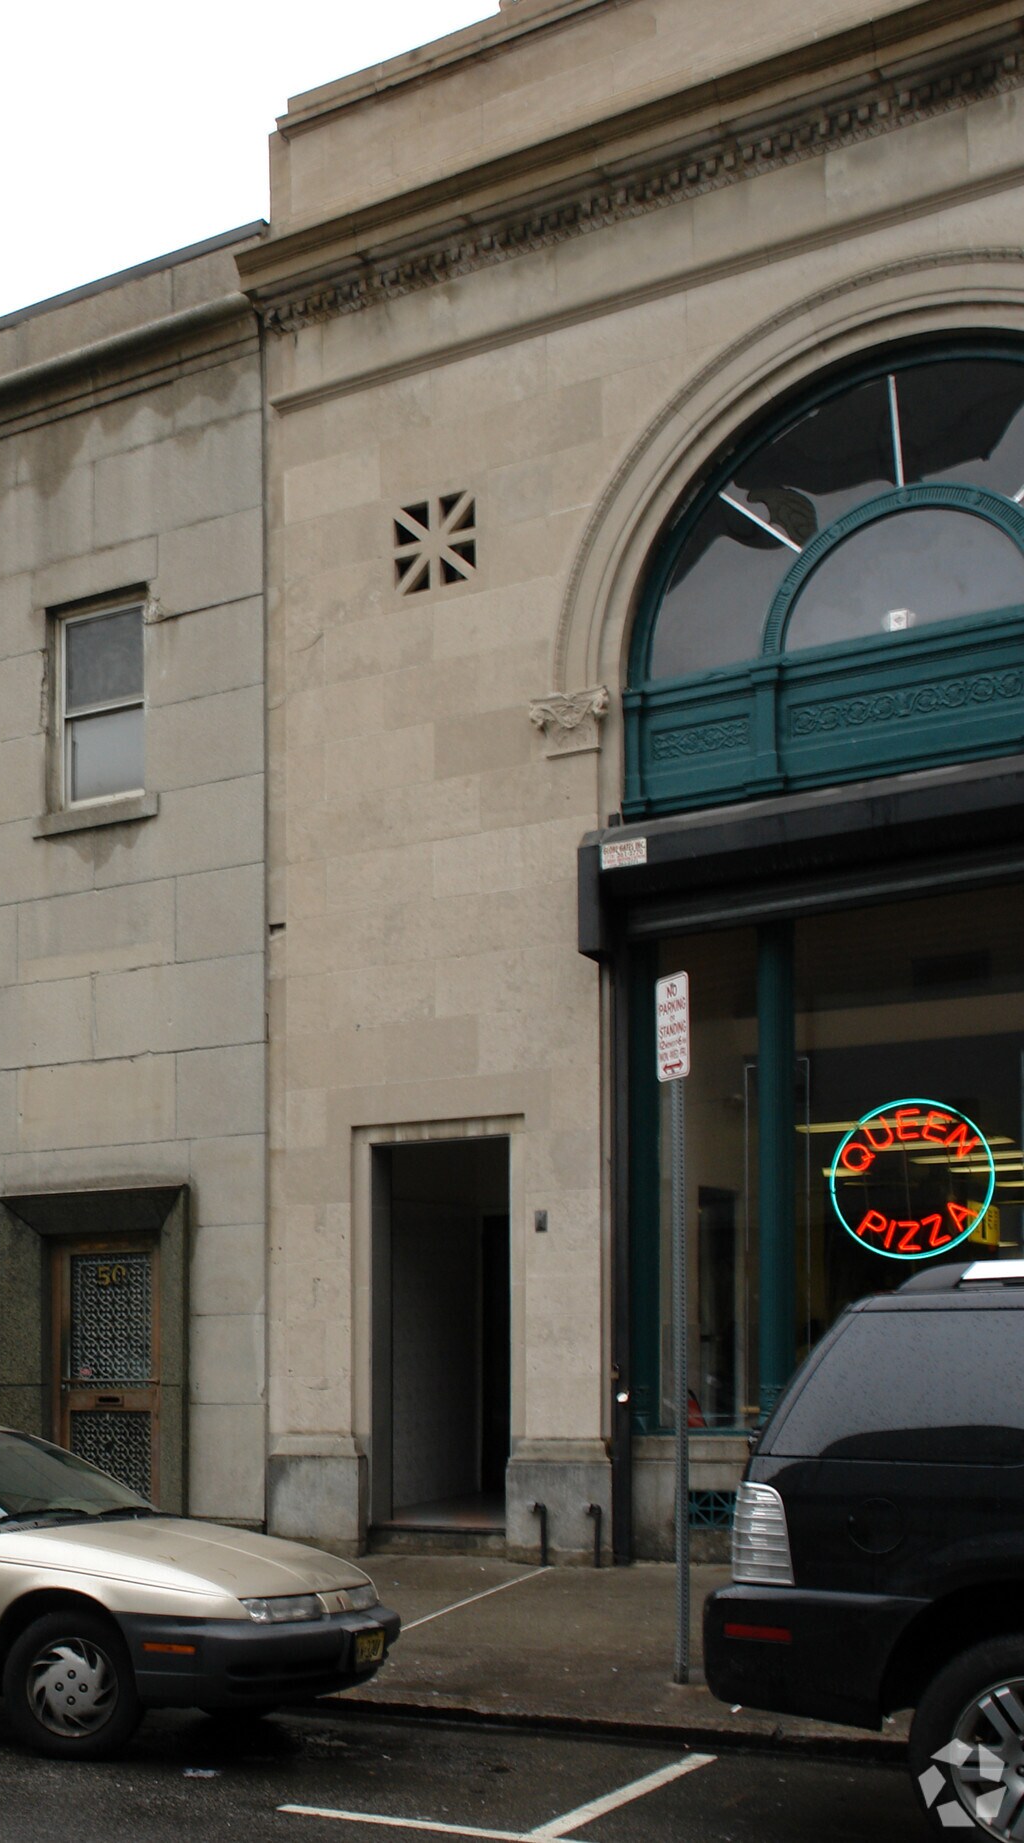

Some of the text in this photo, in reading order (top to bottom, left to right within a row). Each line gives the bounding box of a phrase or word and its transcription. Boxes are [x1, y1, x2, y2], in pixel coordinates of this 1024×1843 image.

[666, 982, 678, 998] NO
[658, 997, 686, 1017] PARKING
[658, 1020, 686, 1041] STANDING
[841, 1108, 981, 1172] QUEEN
[856, 1201, 979, 1252] PIZZA
[97, 1264, 126, 1287] 50
